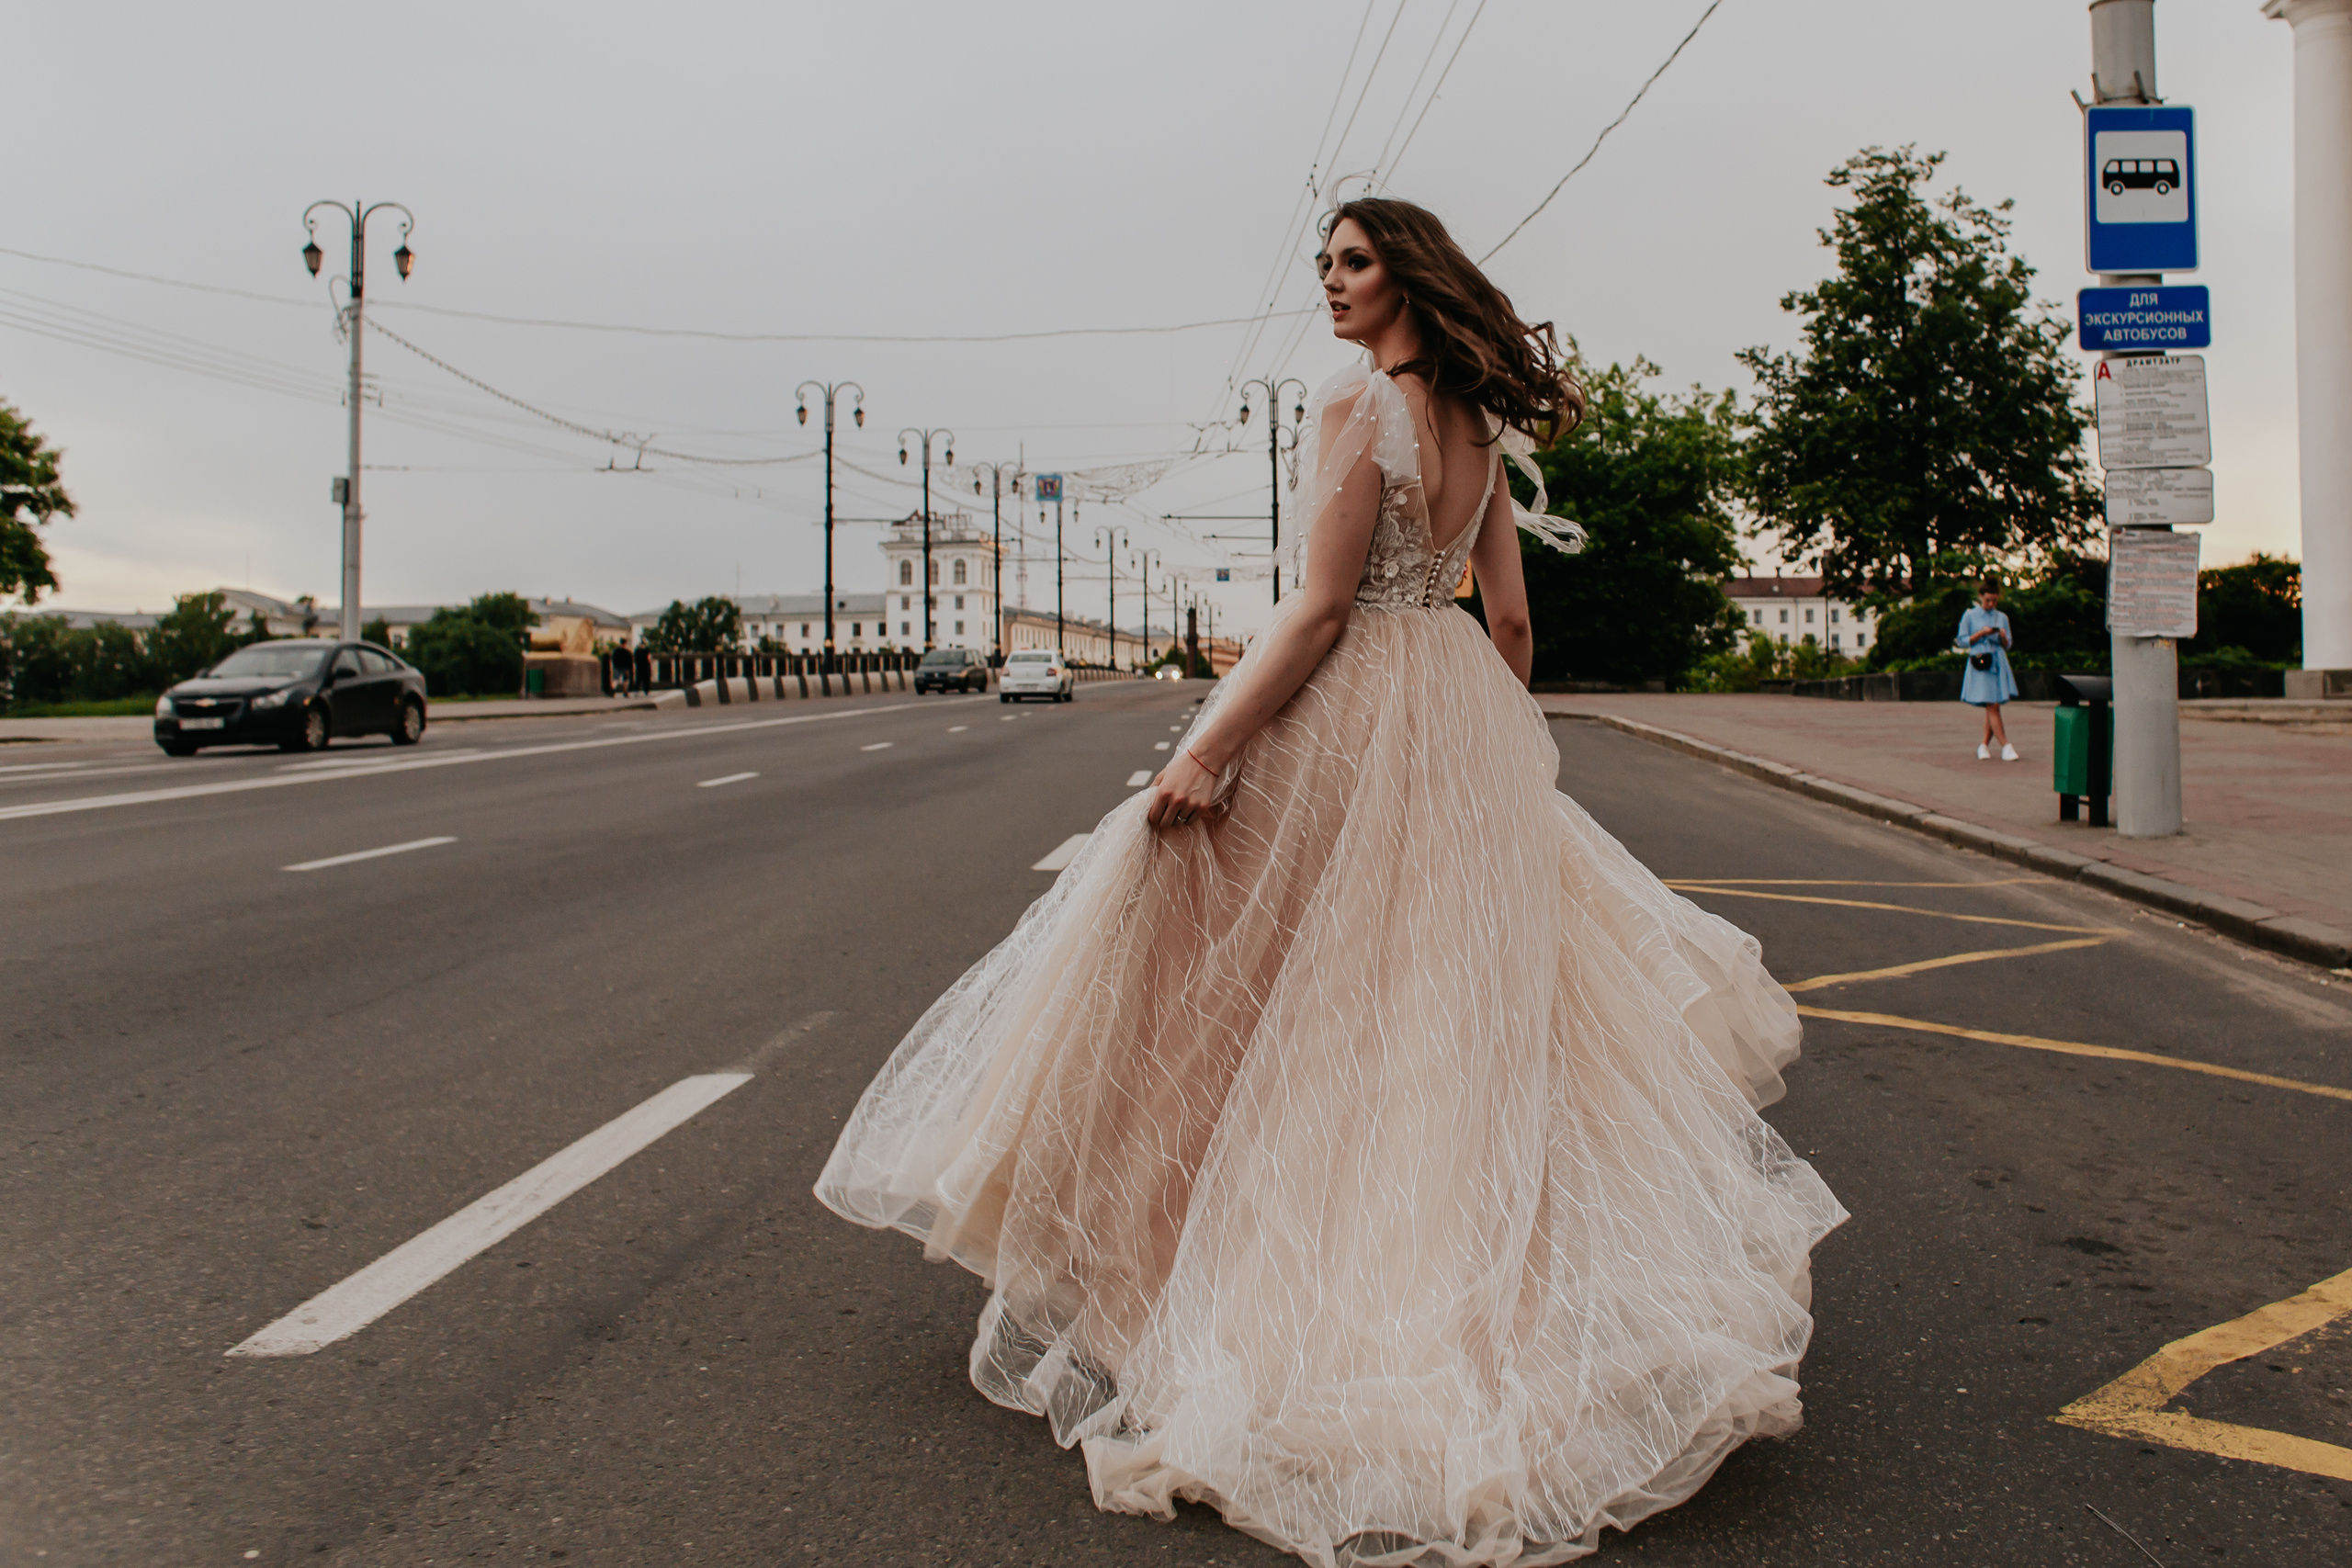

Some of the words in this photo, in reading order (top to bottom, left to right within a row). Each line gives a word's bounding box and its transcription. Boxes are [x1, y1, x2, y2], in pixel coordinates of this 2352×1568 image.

[2130, 293, 2158, 308] ДЛЯ
[2085, 311, 2204, 325] ЭКСКУРСИОННЫХ
[2104, 327, 2187, 341] АВТОБУСОВ
